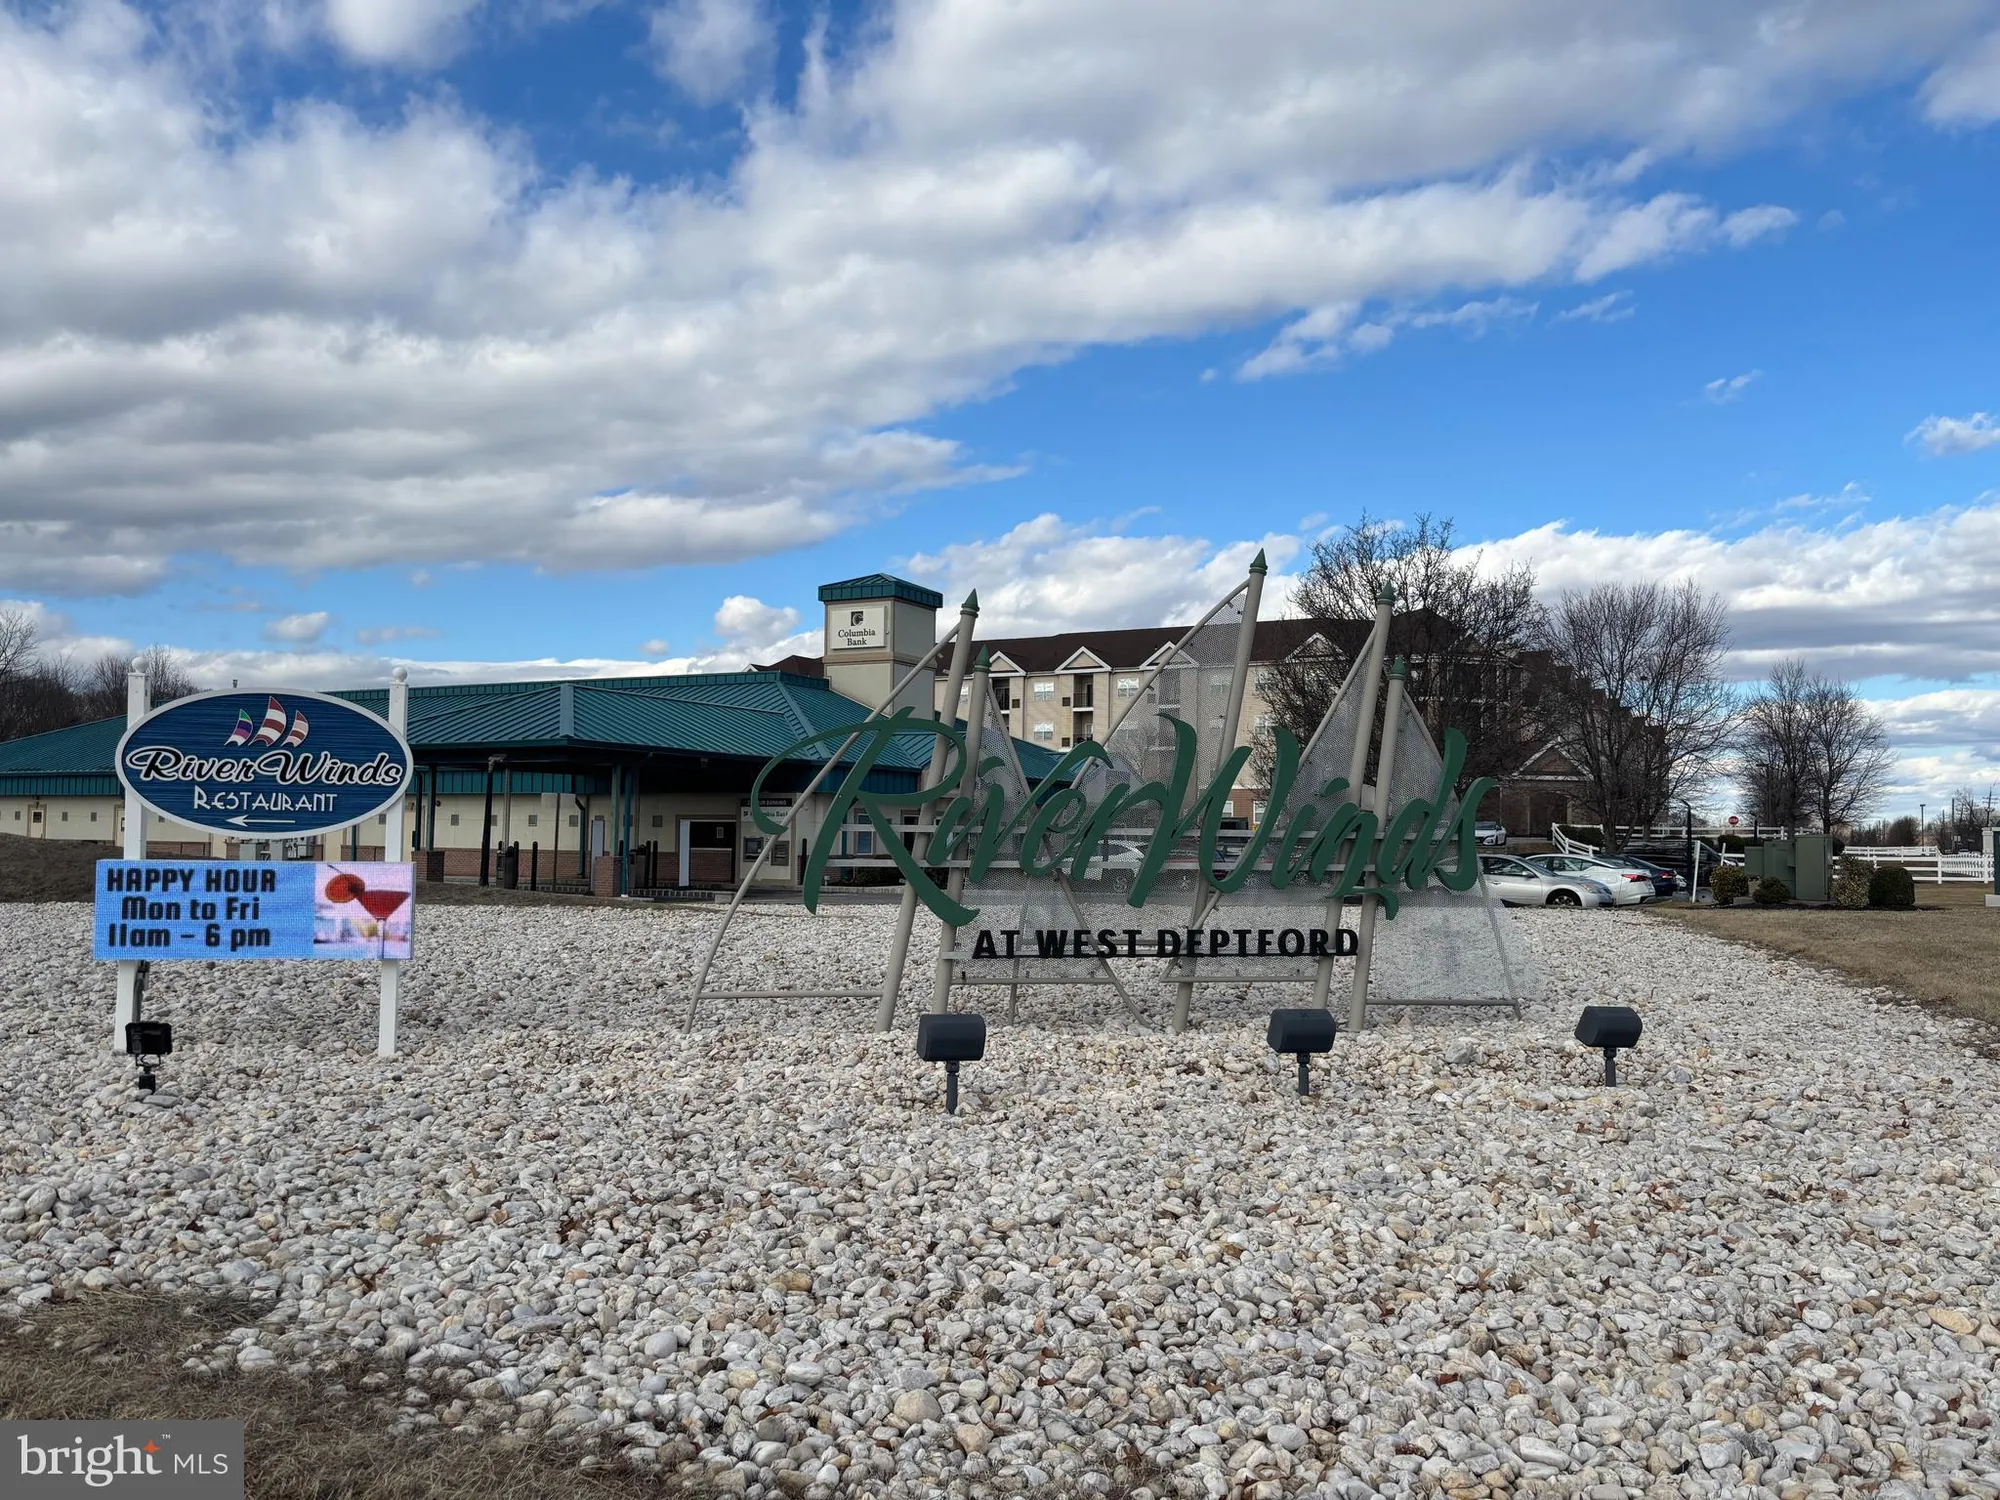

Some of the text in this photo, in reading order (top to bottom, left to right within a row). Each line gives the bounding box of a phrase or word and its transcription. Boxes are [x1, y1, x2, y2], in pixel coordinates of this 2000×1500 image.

[838, 629, 876, 638] Columbia
[847, 637, 867, 646] Bank
[194, 786, 338, 812] RESTAURANT
[107, 868, 276, 892] HAPPY HOUR
[121, 896, 260, 920] Mon to Fri
[108, 924, 170, 947] 11am
[205, 925, 221, 946] 6
[231, 928, 271, 952] pm
[972, 929, 1359, 958] AT WEST DEPTFORD
